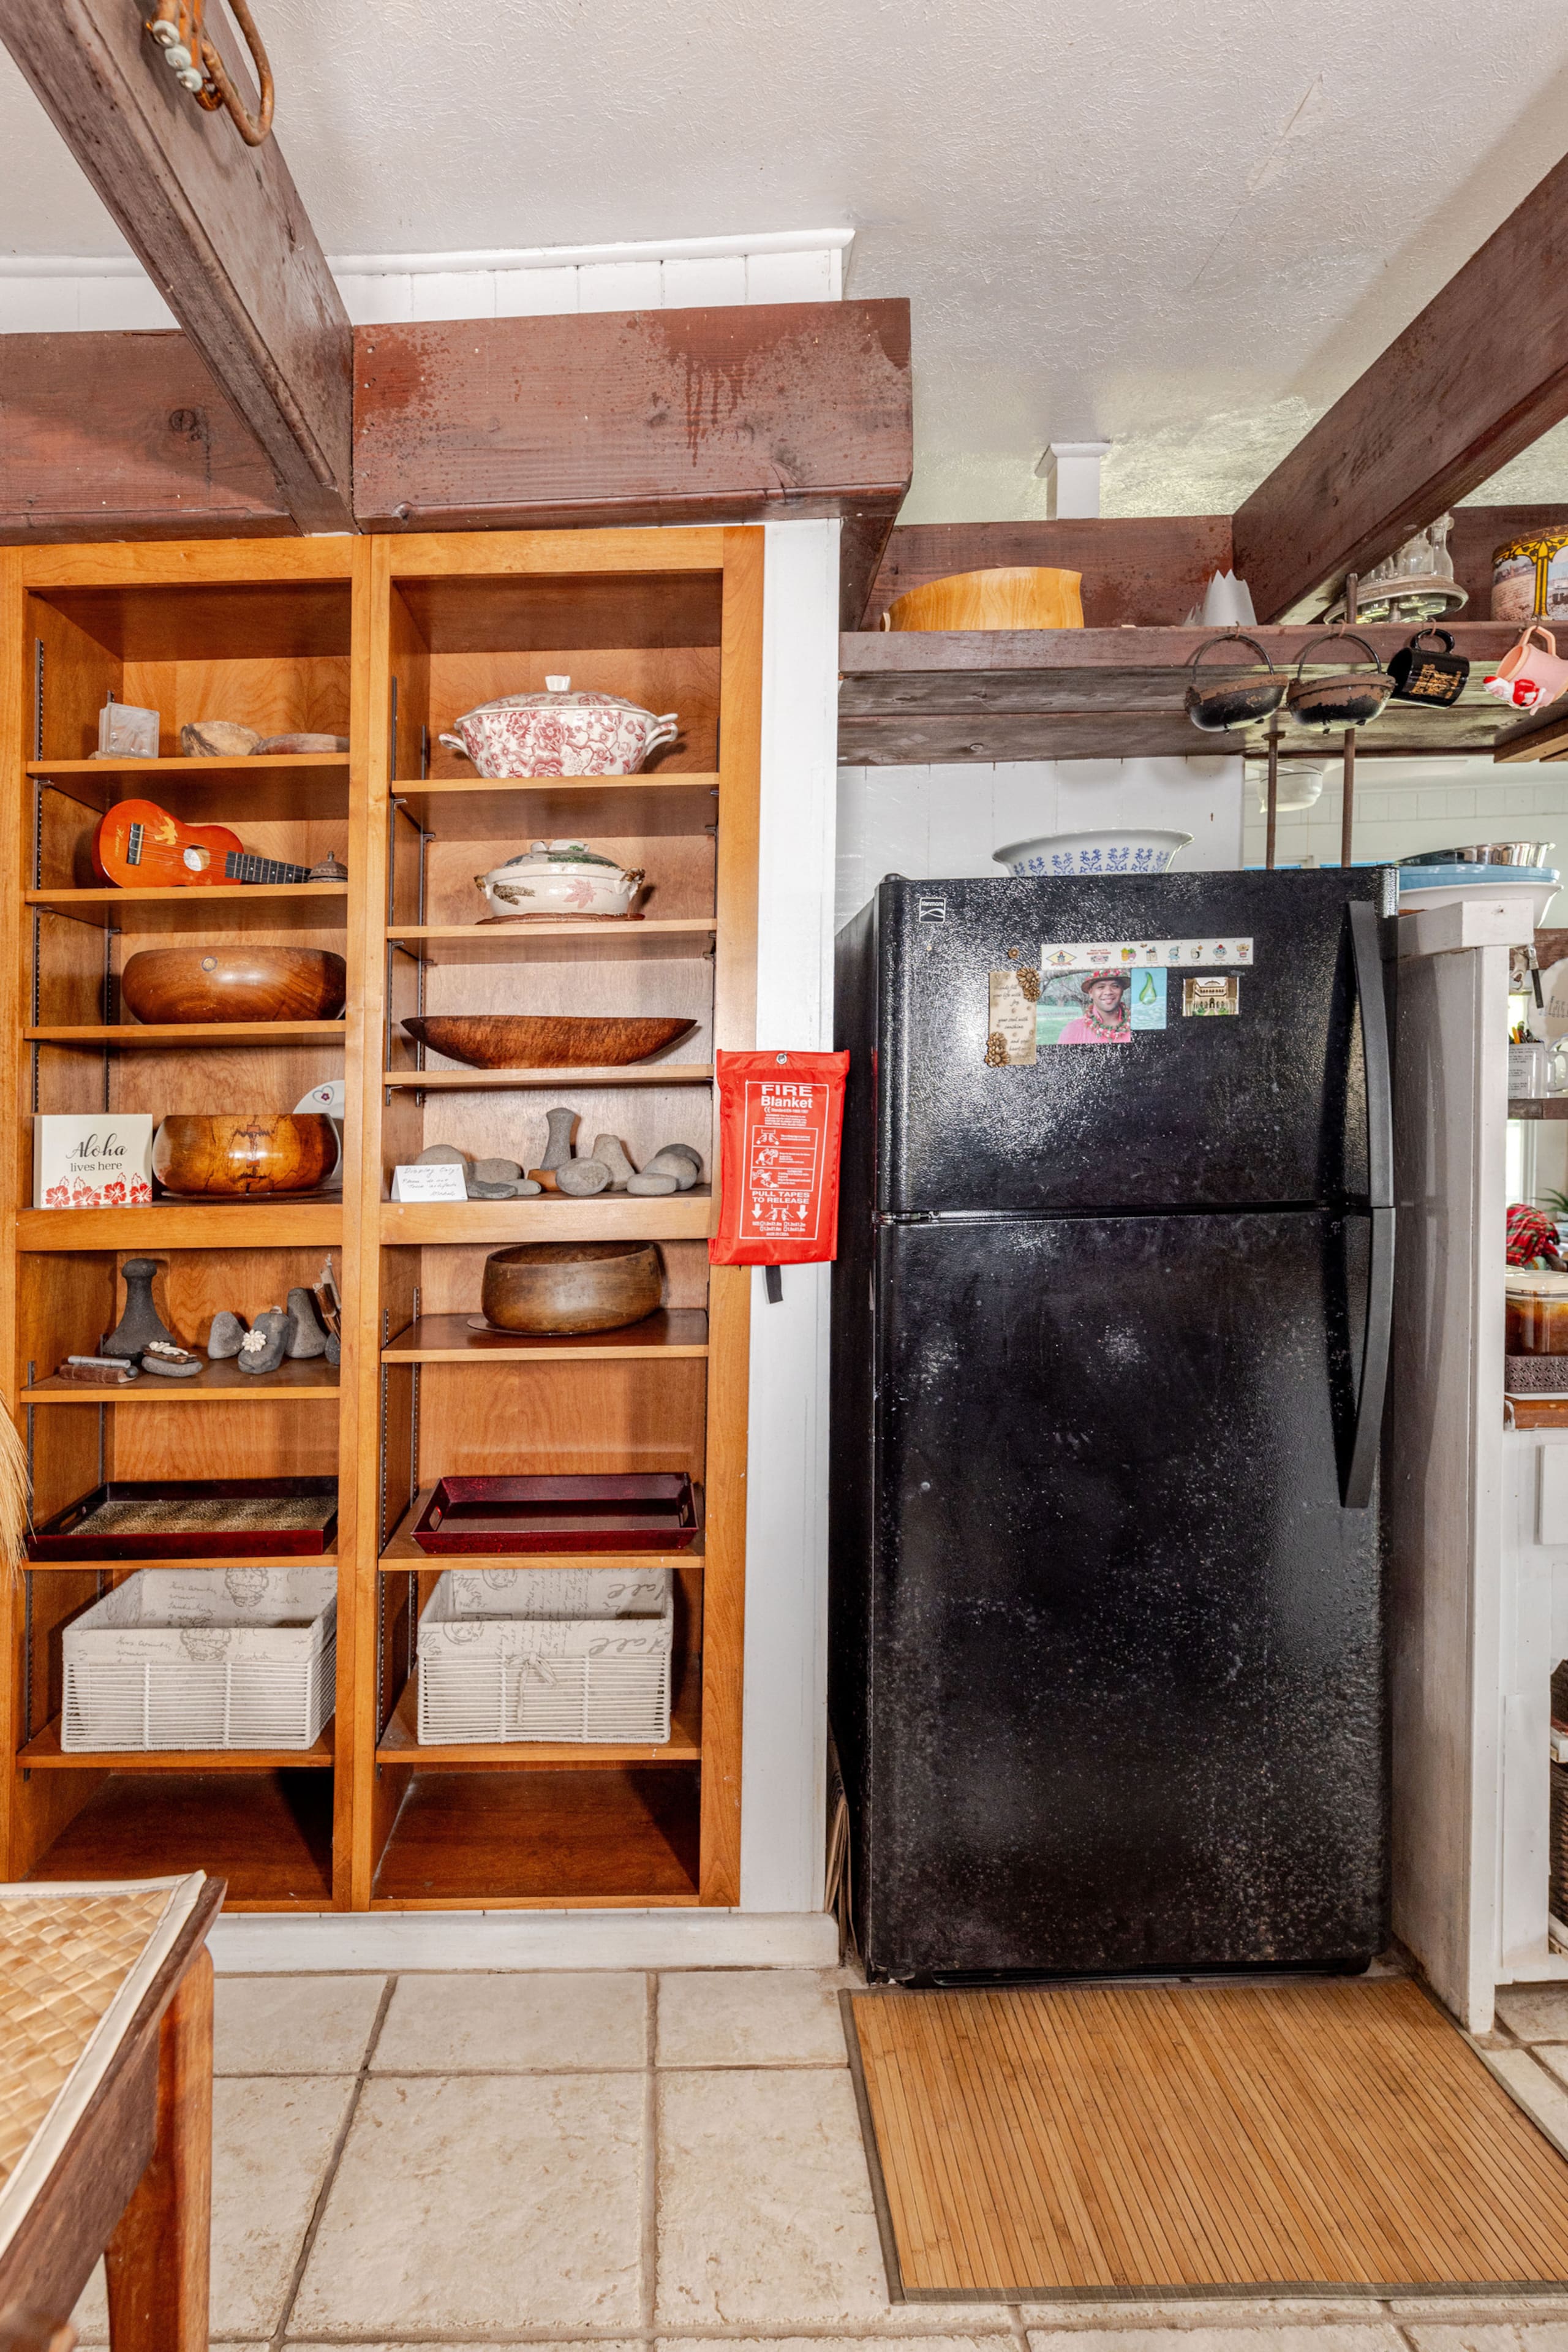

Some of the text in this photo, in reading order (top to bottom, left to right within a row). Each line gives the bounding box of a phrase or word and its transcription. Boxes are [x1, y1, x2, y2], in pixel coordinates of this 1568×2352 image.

[761, 1084, 813, 1097] FIRE
[761, 1095, 813, 1108] Blanket
[66, 1133, 127, 1159] Aloha
[70, 1162, 123, 1172] lives here
[404, 1167, 434, 1178] Display
